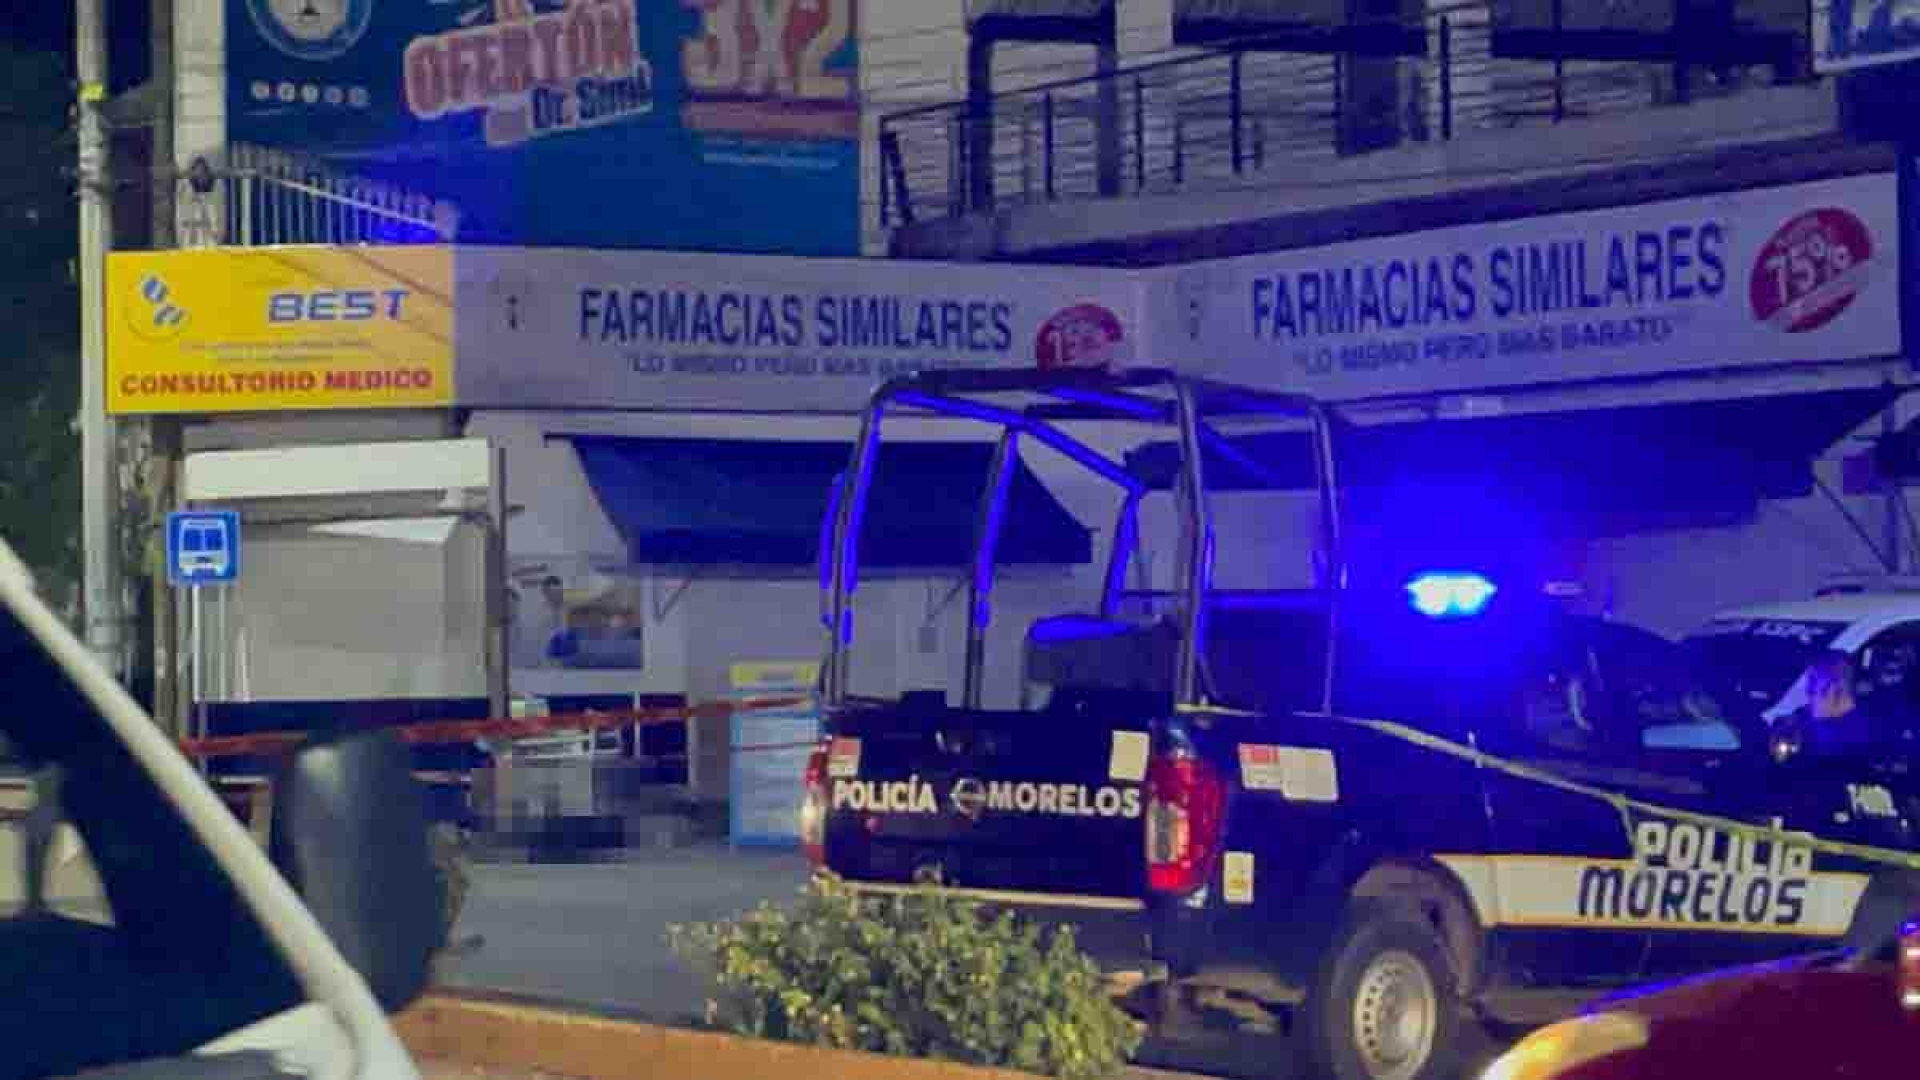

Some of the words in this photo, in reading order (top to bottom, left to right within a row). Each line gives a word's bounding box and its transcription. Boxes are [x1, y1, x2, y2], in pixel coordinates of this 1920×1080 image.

[1252, 251, 1477, 341] FARMACIAS
[1491, 223, 1726, 318] SIMILARES
[1766, 232, 1851, 307] 75%
[268, 290, 409, 323] BEST
[578, 287, 803, 348] FARMACIAS
[816, 295, 1012, 352] SIMILARES
[120, 370, 316, 396] CONSULTORIO
[324, 366, 434, 391] MEDICO
[832, 774, 938, 814] POLICÍA
[986, 782, 1141, 819] MORELOS
[1577, 866, 1806, 925] MORELOS
